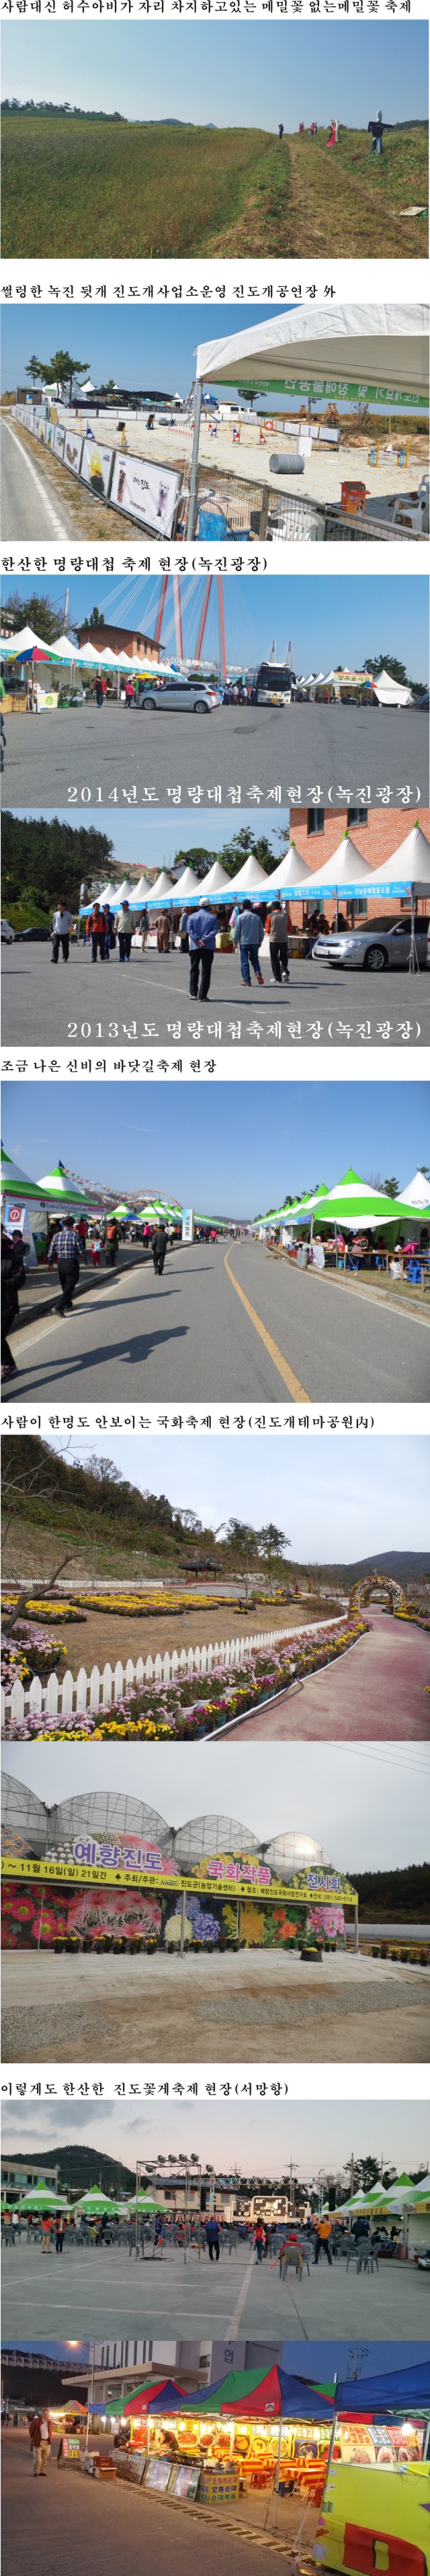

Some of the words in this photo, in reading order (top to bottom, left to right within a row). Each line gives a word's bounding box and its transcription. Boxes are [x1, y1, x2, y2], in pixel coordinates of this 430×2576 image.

[140, 479, 150, 490] 진도
[73, 1842, 163, 1872] 예향진도
[207, 1860, 271, 1885] 국화작품
[306, 1873, 341, 1893] 전시회
[20, 1863, 40, 1873] 11월
[44, 1865, 79, 1877] 16일(일)
[81, 1869, 107, 1880] 21일간
[124, 1874, 159, 1885] 주최/주관:
[181, 1879, 236, 1892] 진도군(농업기술센터)
[212, 2476, 238, 2484] 오징어순대
[211, 2493, 236, 2501] 순대볶음
